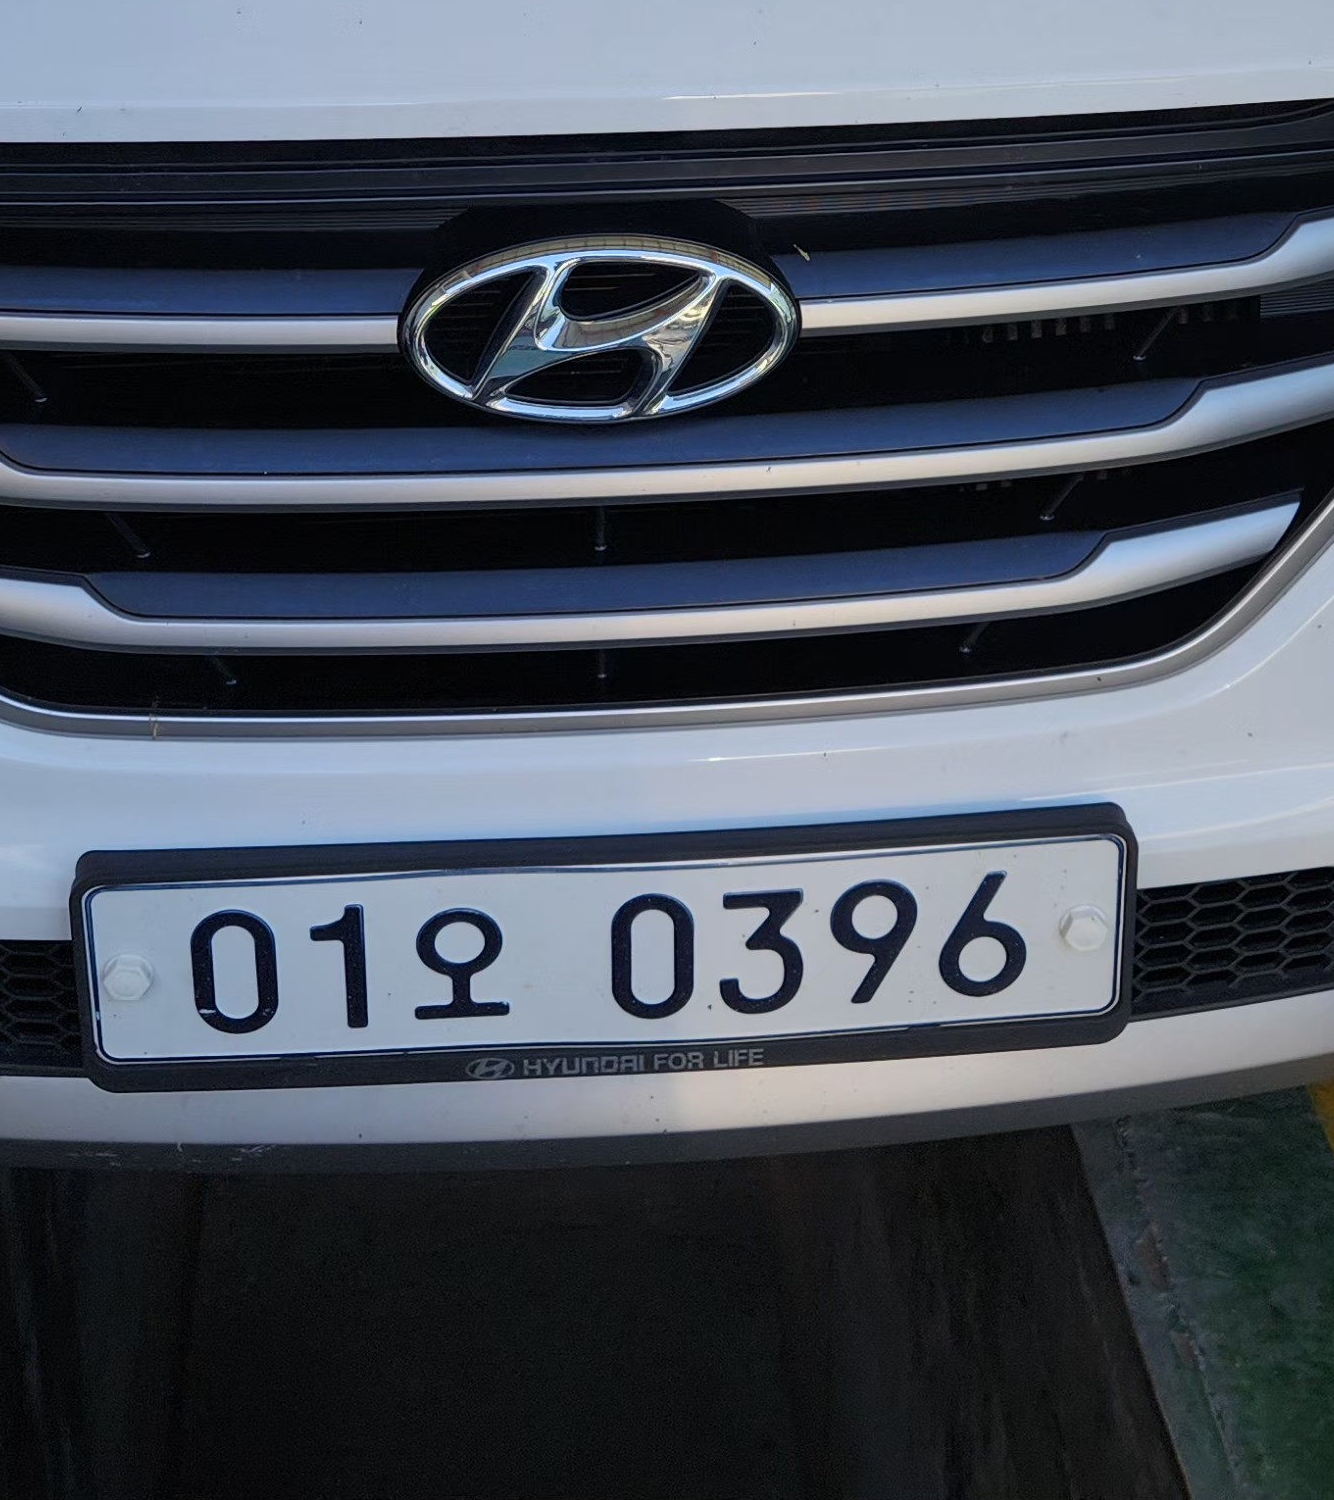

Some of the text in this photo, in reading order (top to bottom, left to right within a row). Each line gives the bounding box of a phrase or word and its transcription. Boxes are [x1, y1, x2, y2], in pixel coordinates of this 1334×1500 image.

[188, 868, 1029, 1037] 01오 0396
[522, 1047, 765, 1078] HYUNDAI FOR LIFE
